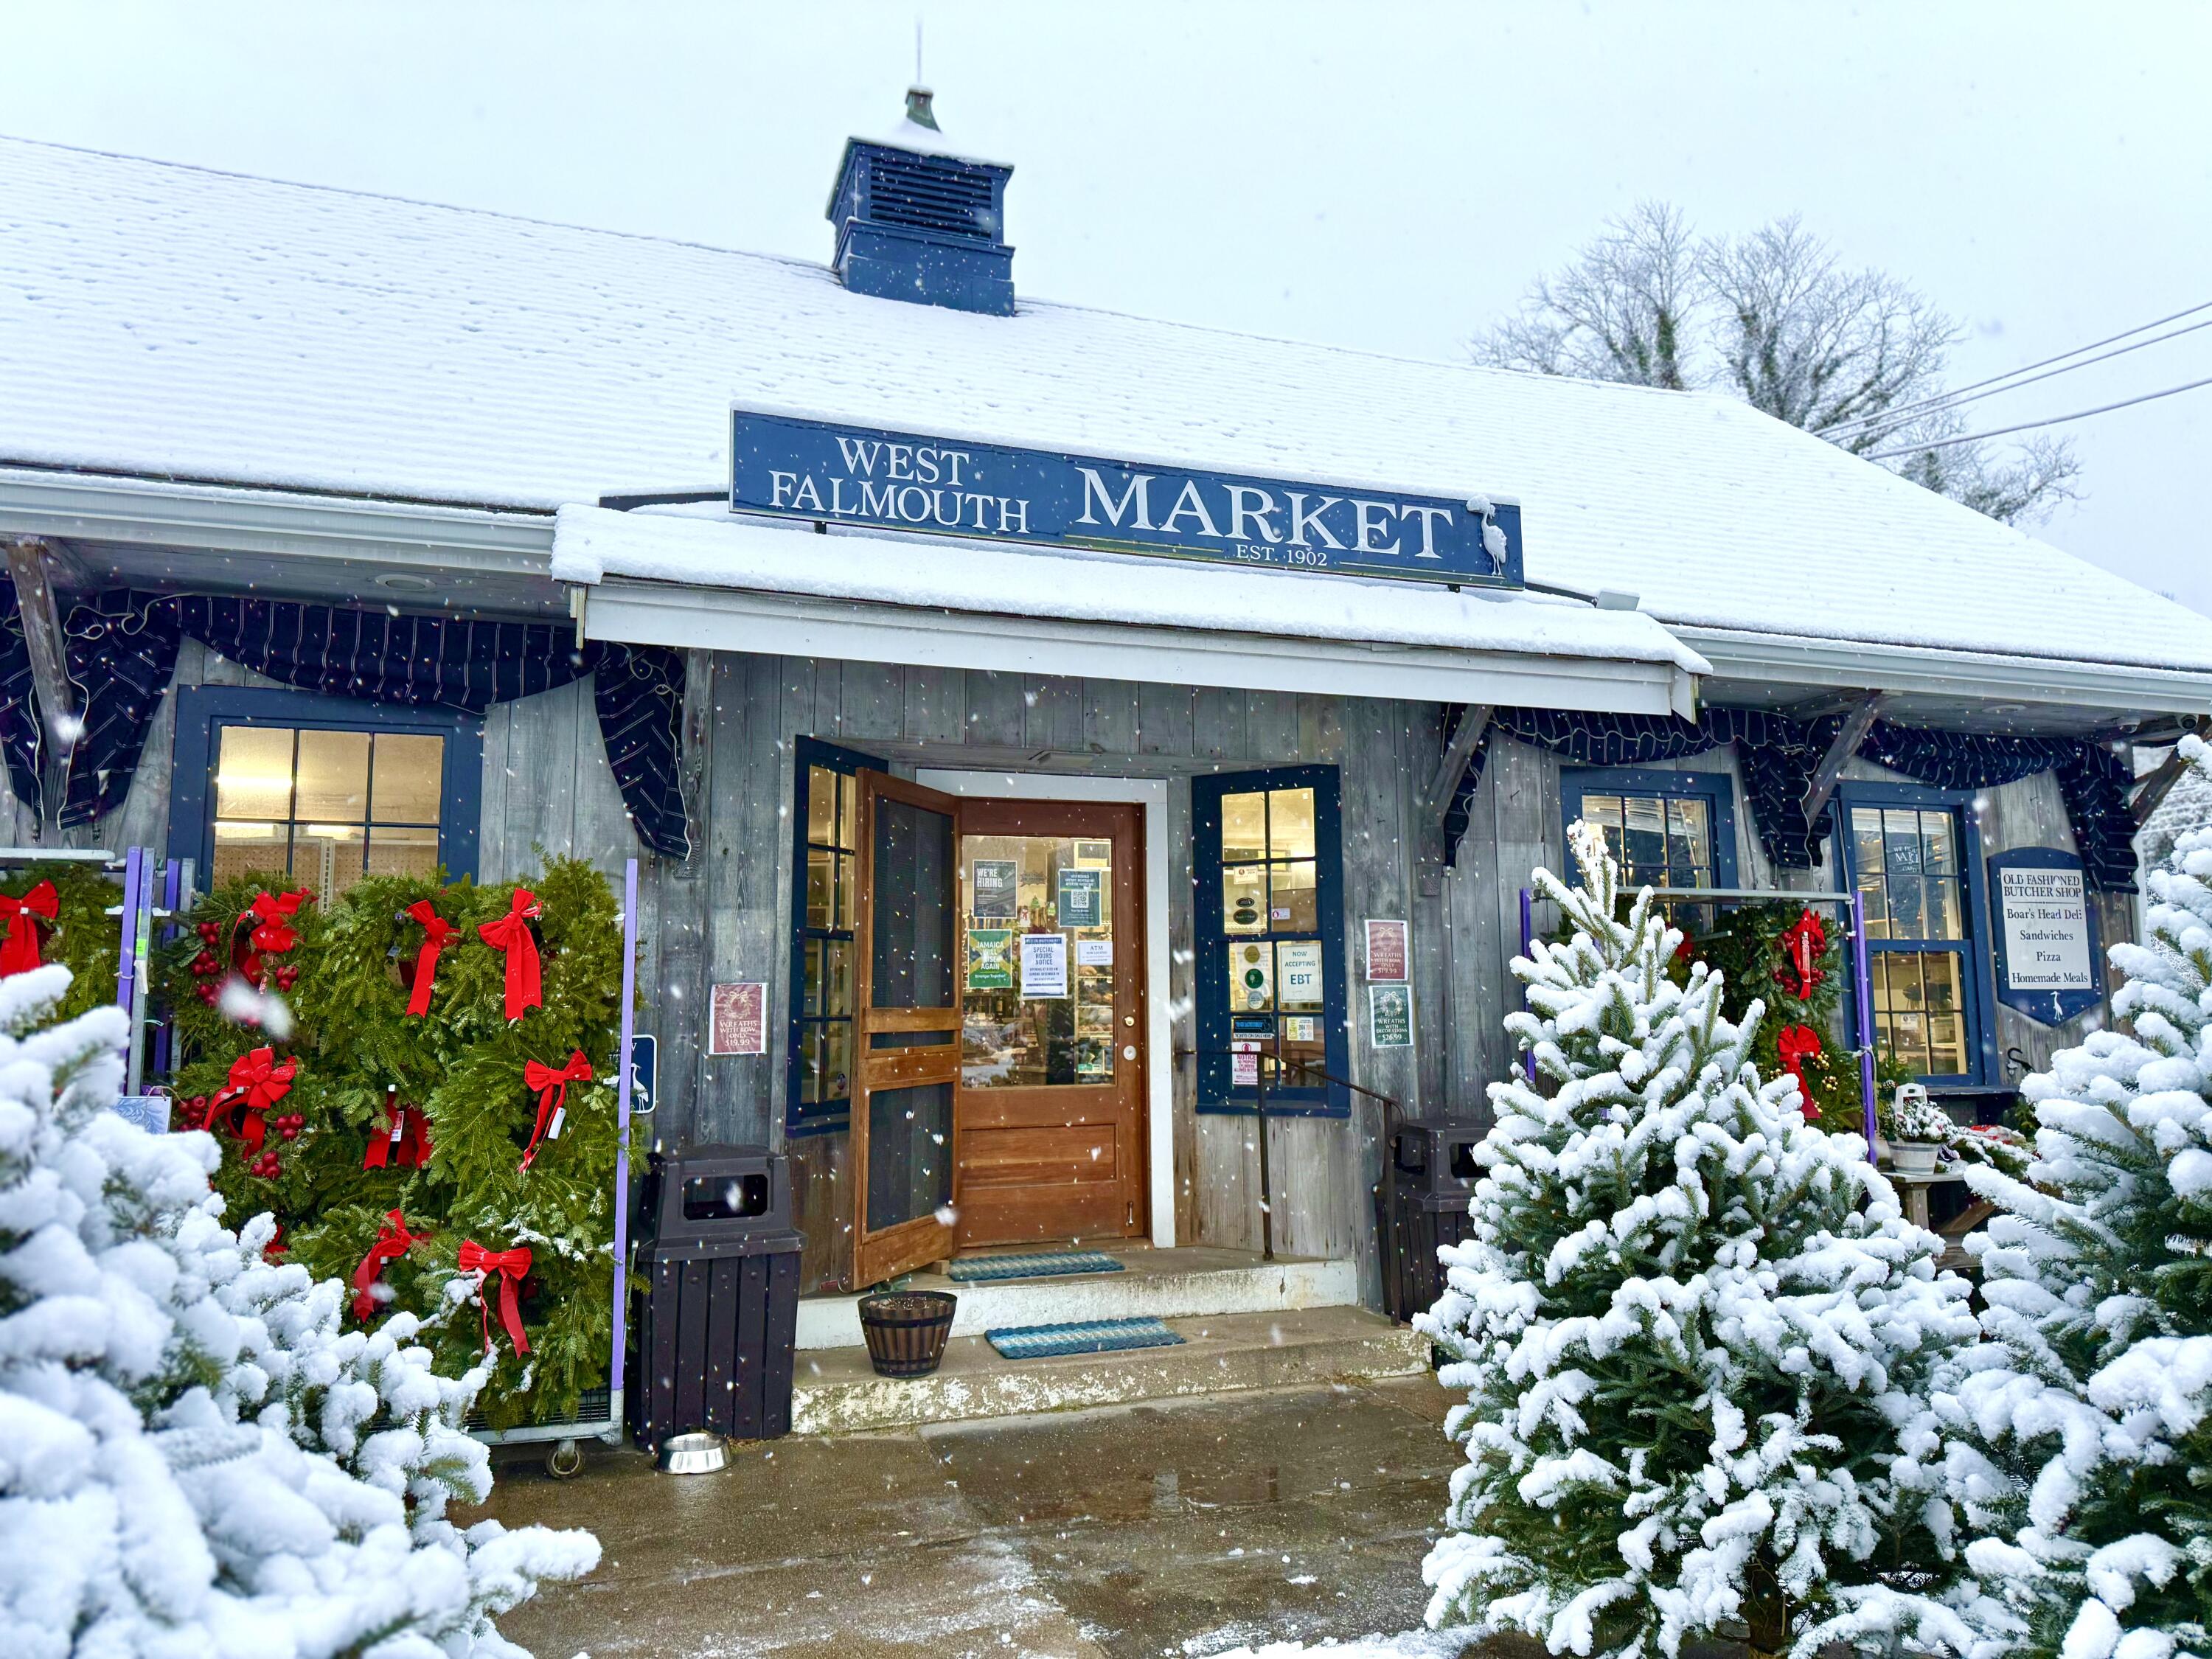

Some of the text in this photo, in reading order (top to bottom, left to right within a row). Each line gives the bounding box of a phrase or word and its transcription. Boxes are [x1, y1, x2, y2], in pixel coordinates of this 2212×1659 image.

[835, 437, 970, 487] WEST
[768, 470, 1030, 534] FALMOUTH
[1074, 467, 1453, 560] MARKET
[1235, 544, 1328, 567] EST. 1902
[976, 868, 998, 877] WE'RE
[977, 877, 1003, 888] HIRING
[2003, 874, 2080, 886] OLD FASHIONED
[2004, 886, 2081, 898] BUTCHER SHOP
[2007, 908, 2035, 919] Boar's
[2038, 908, 2062, 919] Head
[2020, 930, 2073, 941] Sandwiches
[2036, 951, 2061, 961] Pizza
[1290, 974, 1312, 985] EBT
[2012, 972, 2088, 983] Homemade Meals
